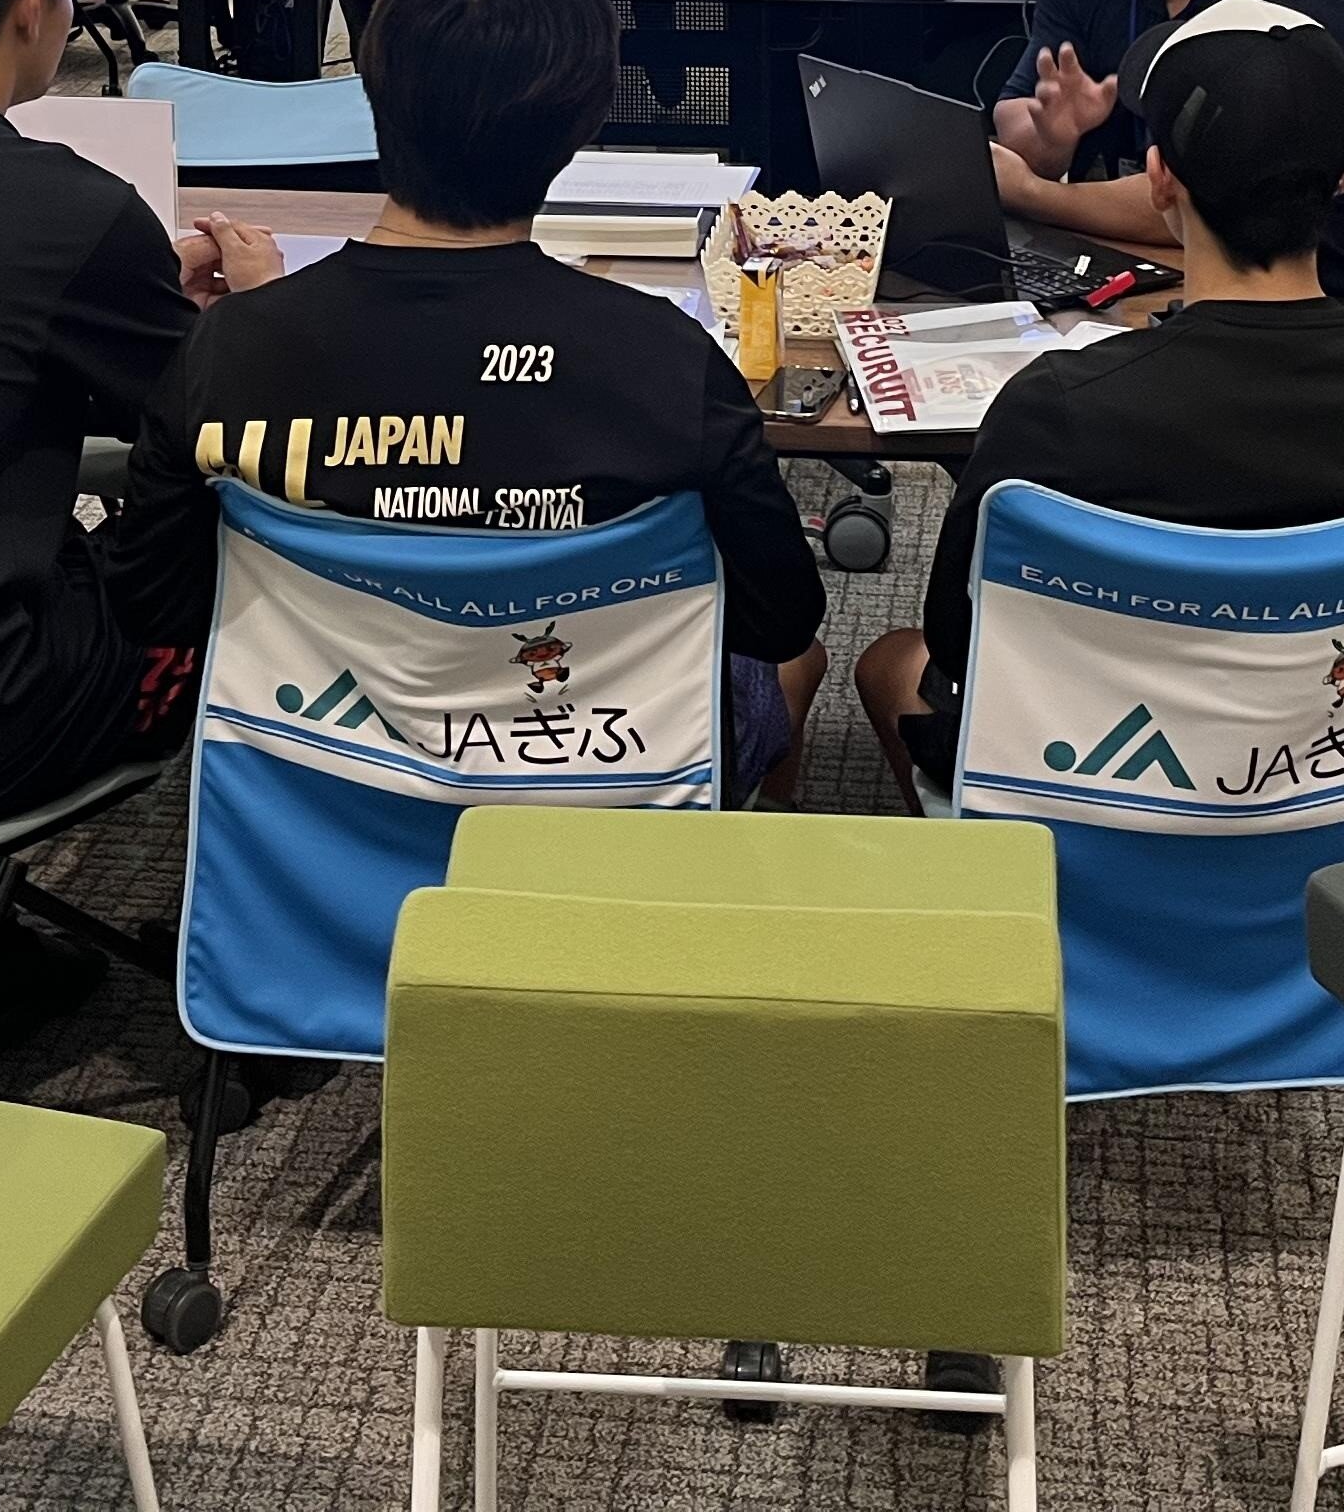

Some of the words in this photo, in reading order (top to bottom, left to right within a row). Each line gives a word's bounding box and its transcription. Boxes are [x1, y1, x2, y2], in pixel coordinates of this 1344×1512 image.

[481, 344, 555, 383] 2023
[324, 415, 465, 466] JAPAN
[373, 486, 486, 519] NATIONAL
[393, 586, 452, 612] ALL
[460, 600, 526, 617] ALL
[535, 586, 602, 611] FOR
[610, 568, 683, 596] ONE
[1019, 563, 1120, 604] EACH
[1130, 593, 1201, 617] FOR
[1210, 603, 1280, 622] ALL
[417, 702, 647, 765] JAぎふ
